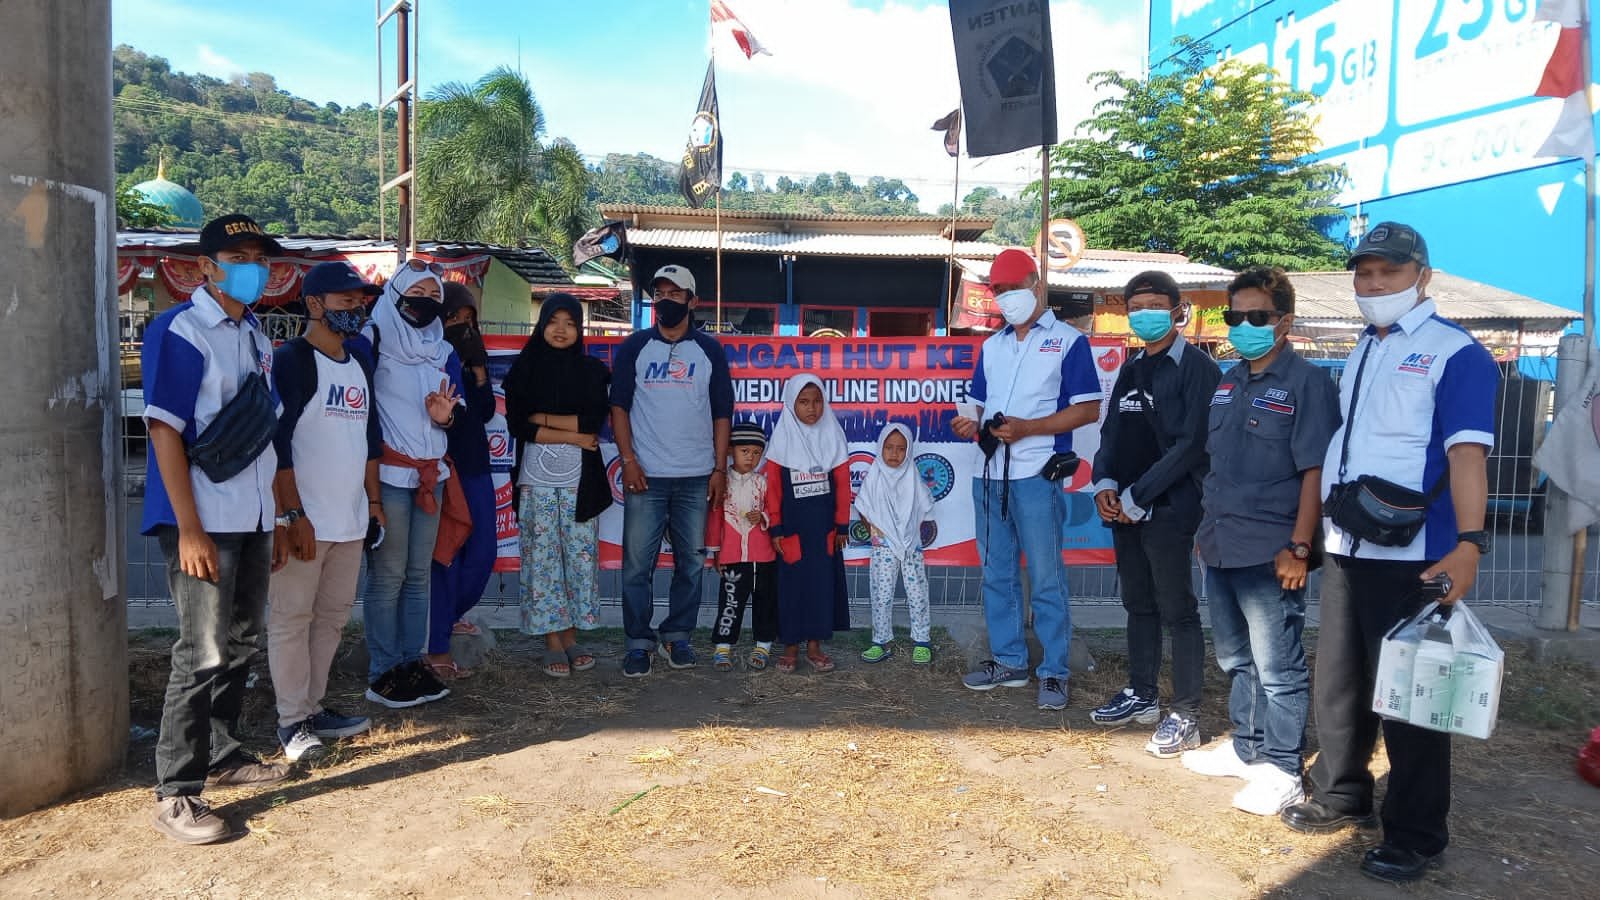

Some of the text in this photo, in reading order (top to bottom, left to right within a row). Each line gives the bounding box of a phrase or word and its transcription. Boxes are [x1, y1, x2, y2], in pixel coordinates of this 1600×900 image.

[842, 344, 916, 369] HUT
[927, 344, 973, 369] KE
[1404, 352, 1437, 365] MOI
[645, 359, 696, 380] MOI
[326, 383, 368, 409] MOI
[719, 582, 738, 636] adidas
